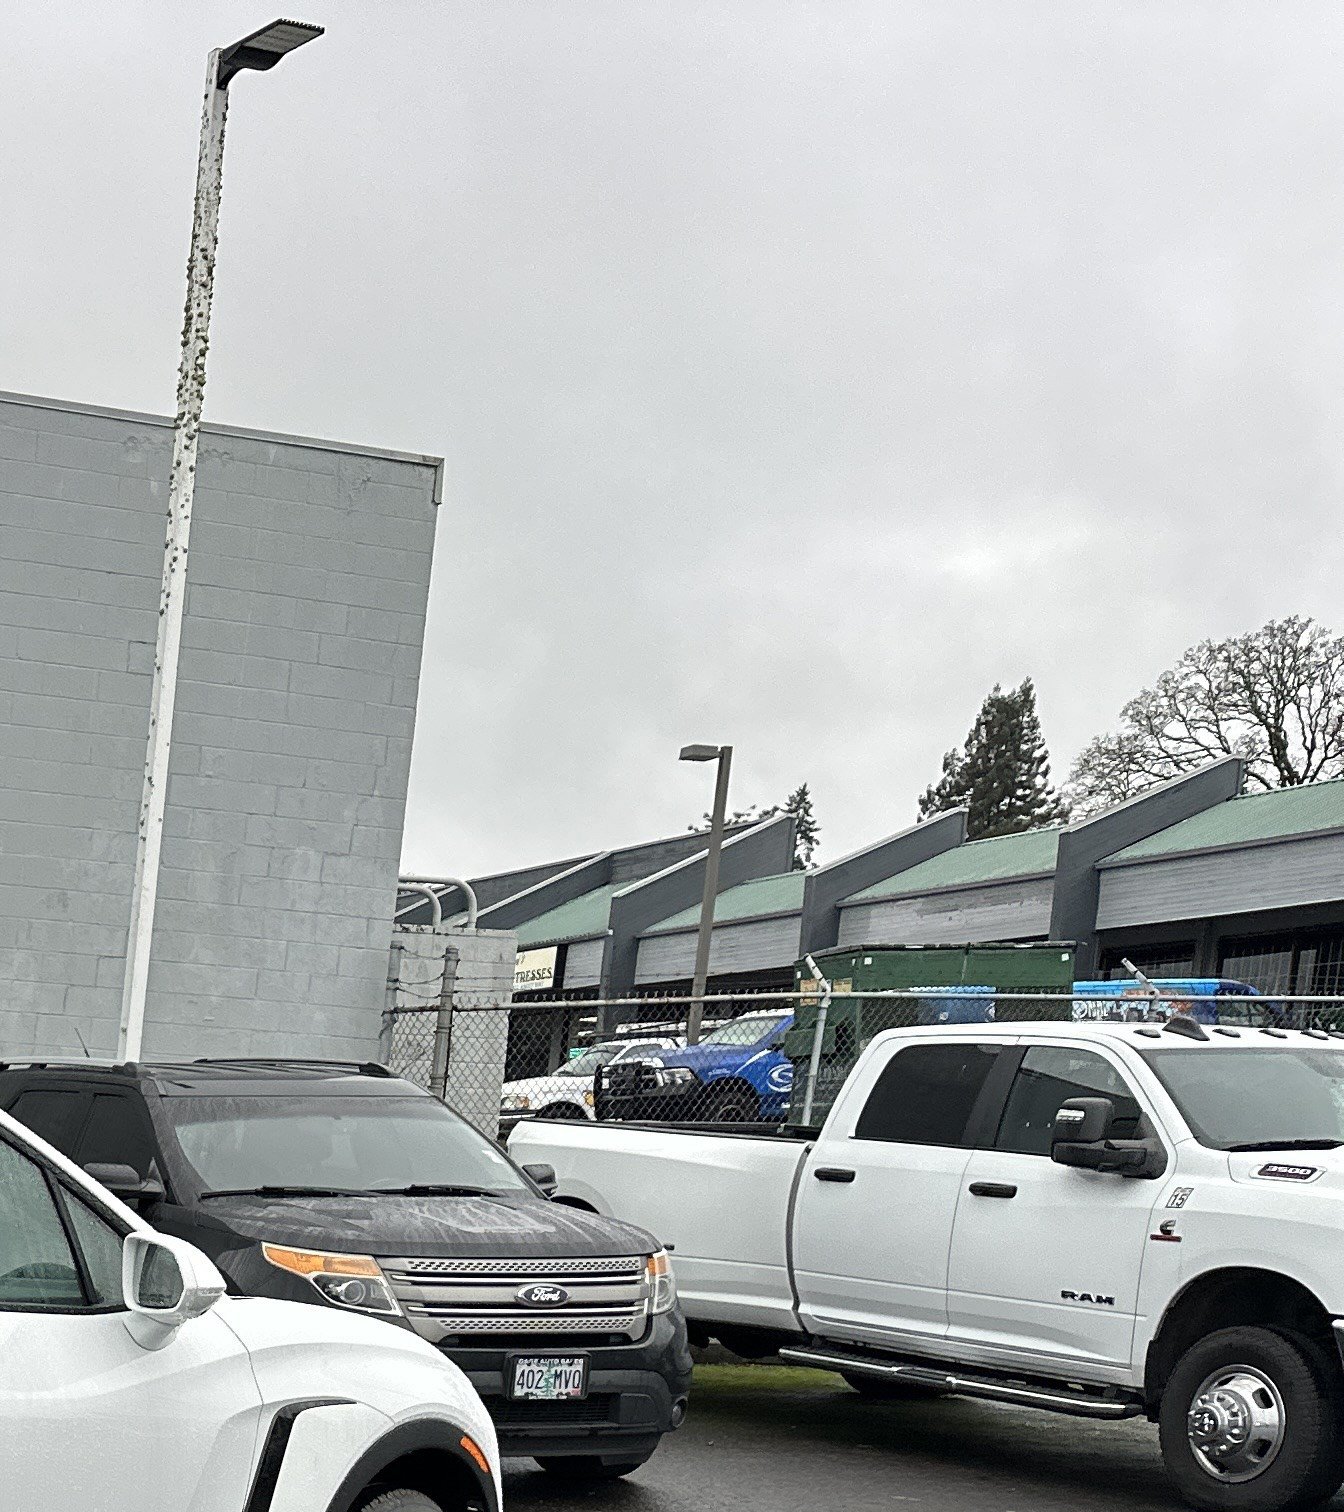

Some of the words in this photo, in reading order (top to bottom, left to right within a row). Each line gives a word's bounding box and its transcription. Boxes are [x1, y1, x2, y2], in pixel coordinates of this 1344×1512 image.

[531, 1286, 561, 1301] Ford
[1061, 1289, 1115, 1306] RAM
[517, 1369, 544, 1390] 402
